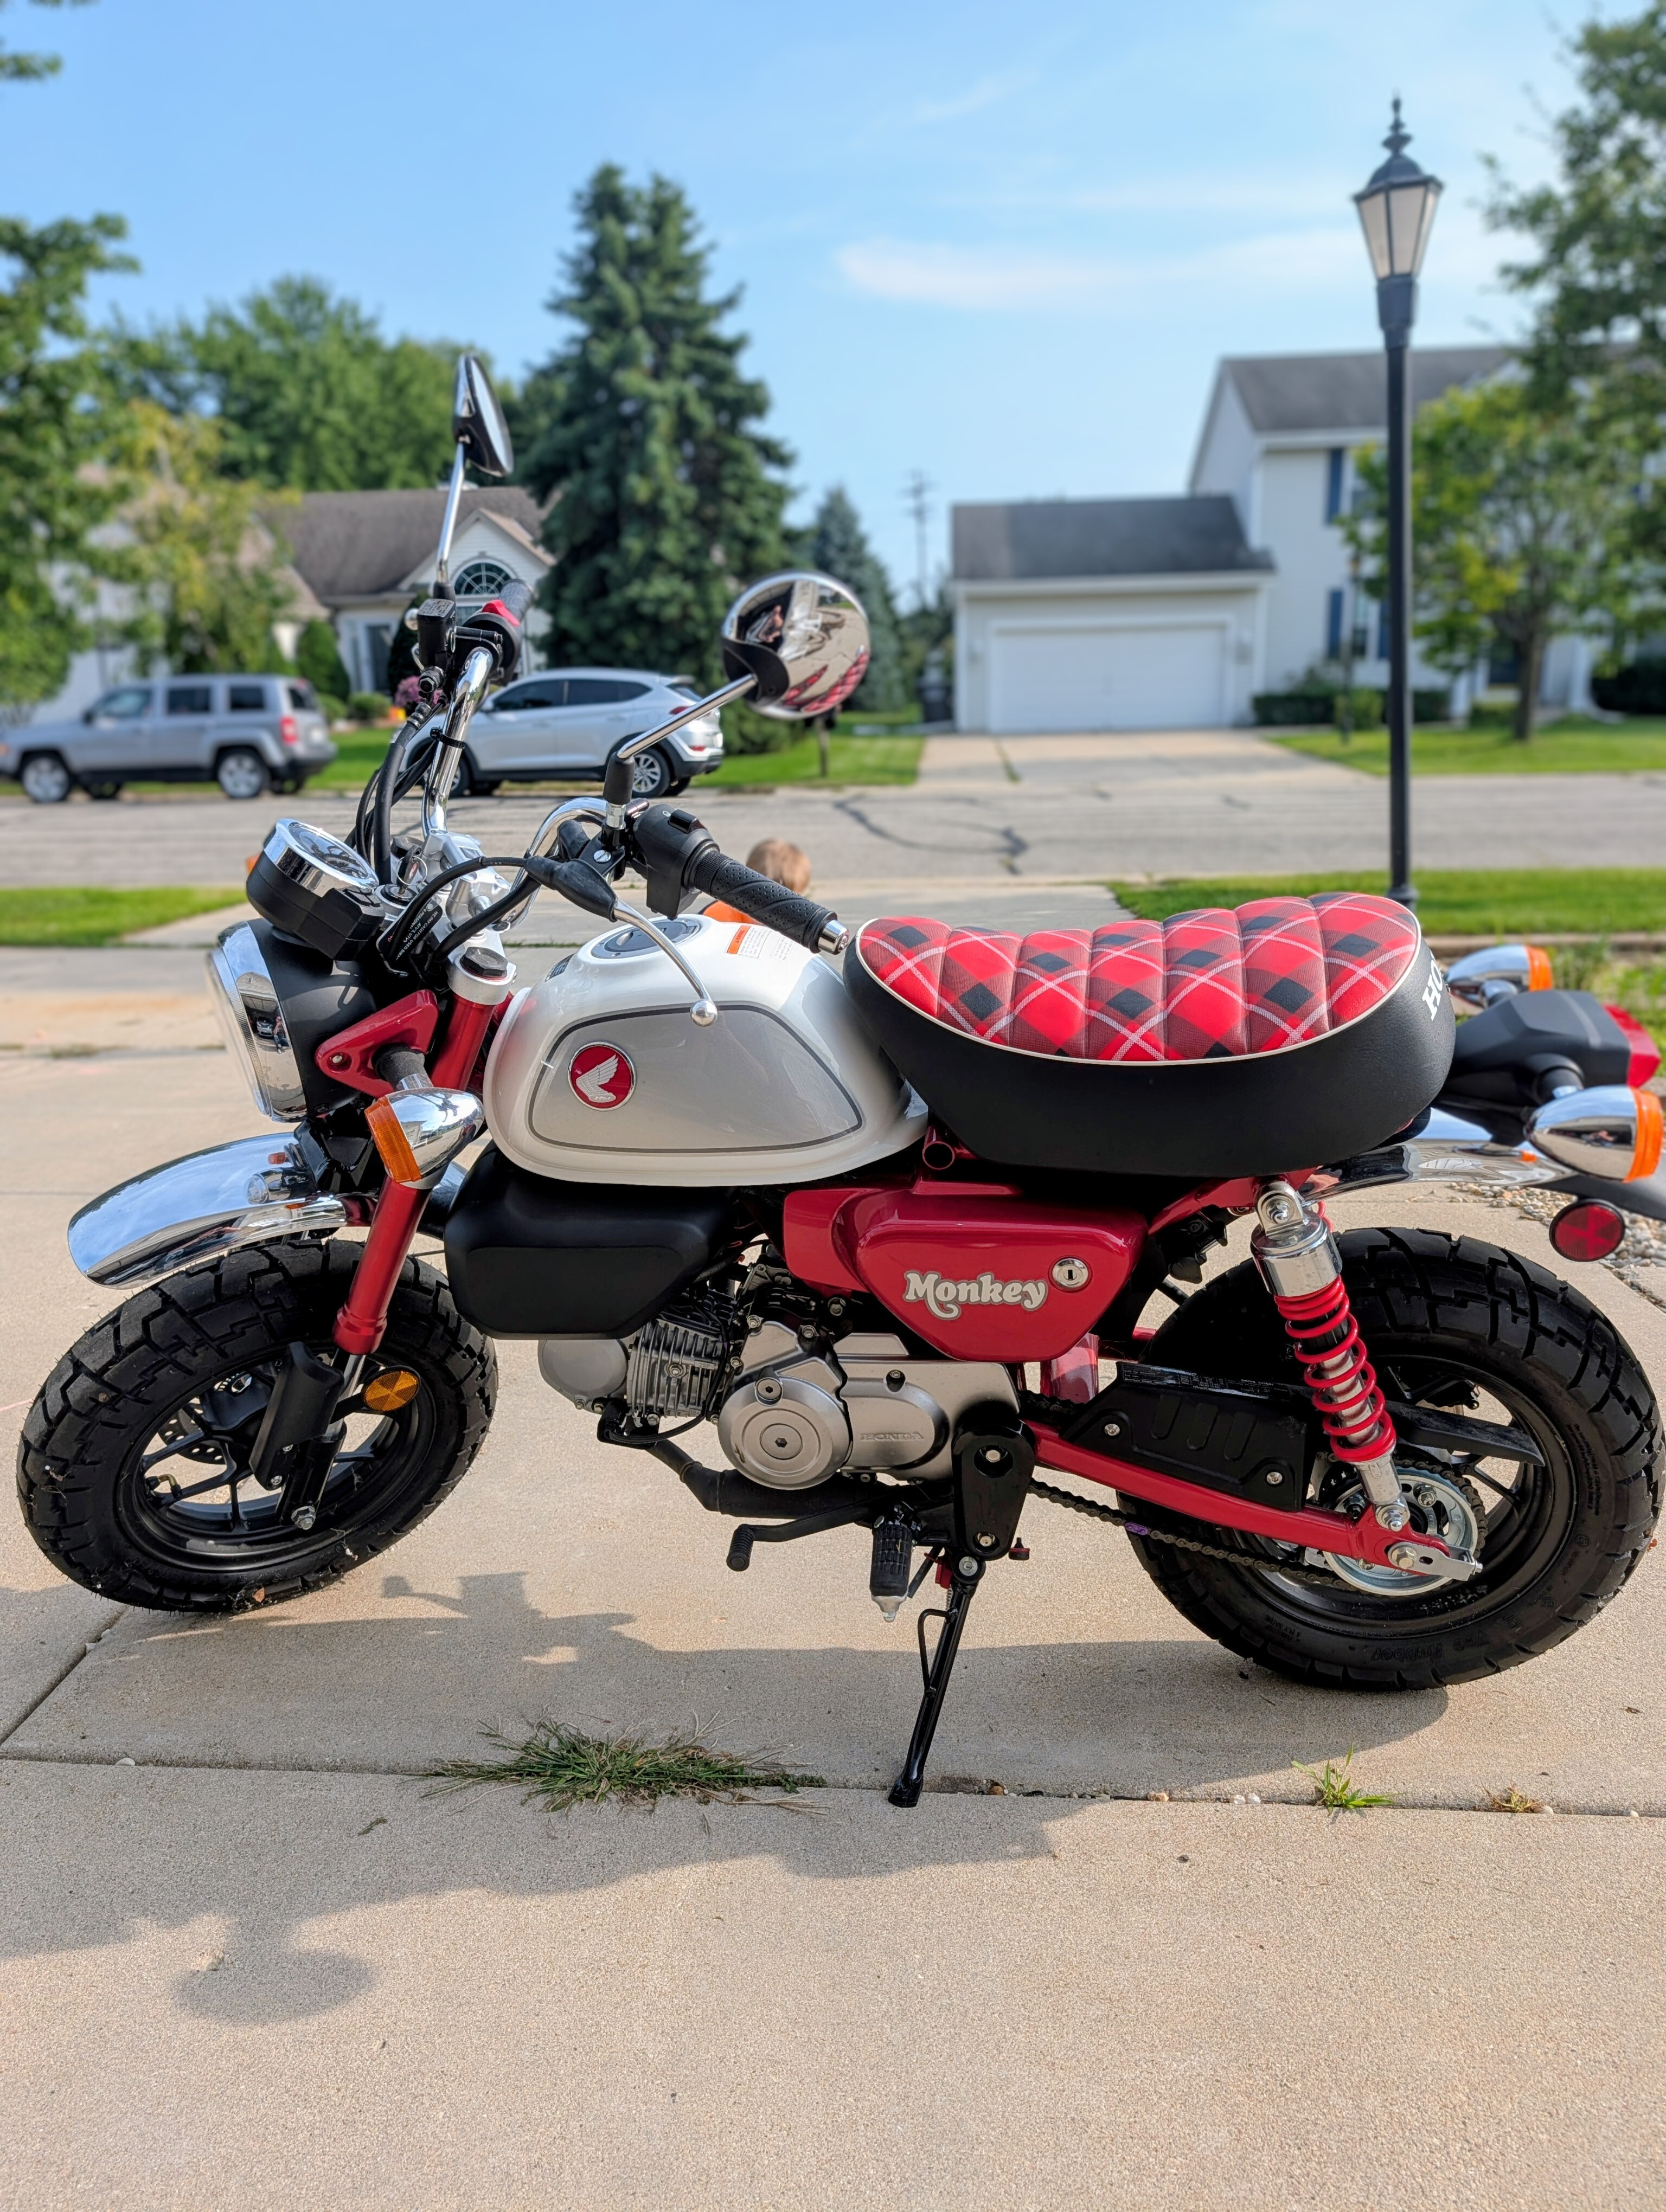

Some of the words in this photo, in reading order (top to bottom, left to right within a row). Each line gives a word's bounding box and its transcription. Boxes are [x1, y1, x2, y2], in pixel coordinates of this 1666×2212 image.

[419, 923, 428, 934] CASH
[404, 940, 414, 950] USED
[1422, 950, 1443, 1021] HO
[904, 1271, 1048, 1320] Monkey
[861, 1432, 924, 1441] HONDA
